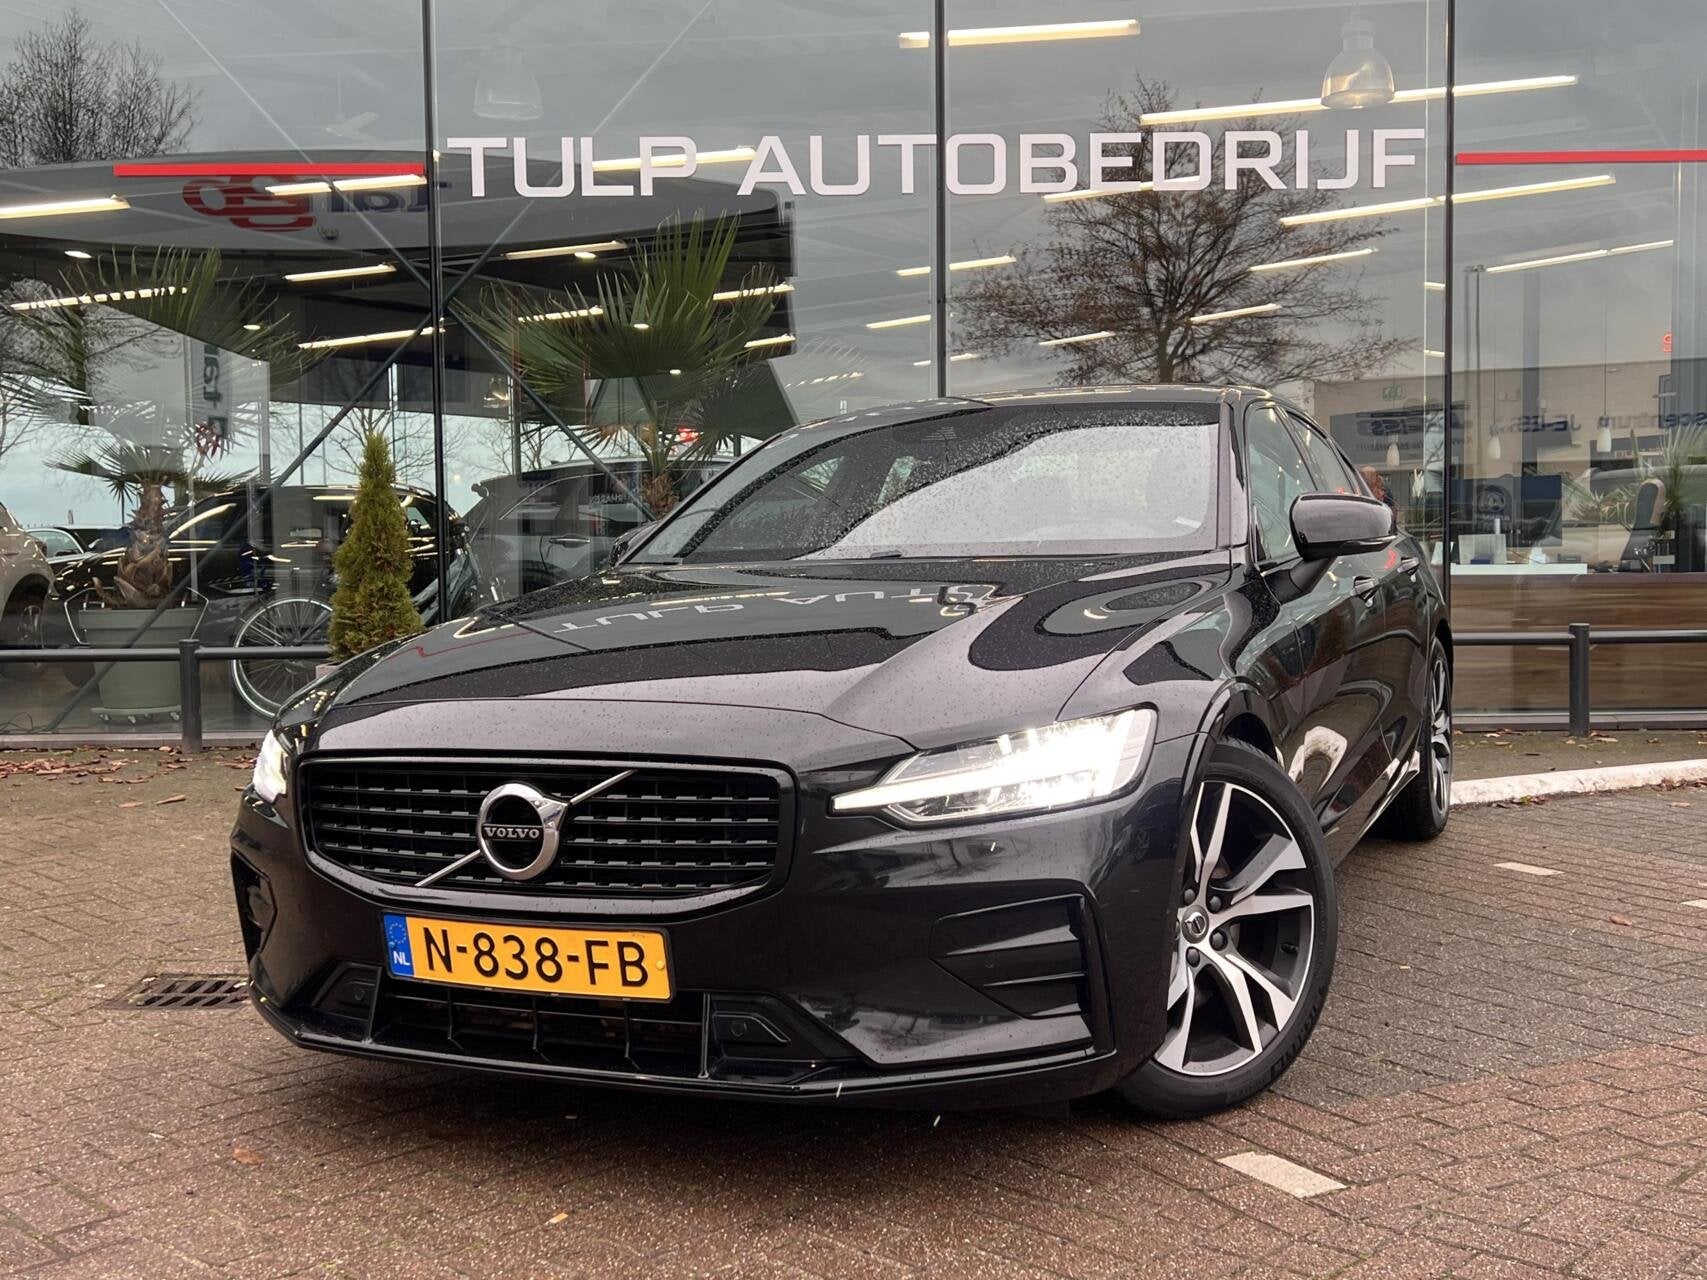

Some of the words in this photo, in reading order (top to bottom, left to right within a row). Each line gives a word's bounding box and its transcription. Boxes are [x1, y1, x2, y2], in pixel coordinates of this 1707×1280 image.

[446, 136, 698, 199] TULP
[736, 127, 1426, 197] AUTOBEDRIJF
[484, 826, 541, 840] VOLVO
[393, 950, 411, 967] NL
[423, 926, 649, 988] N-838-FB
